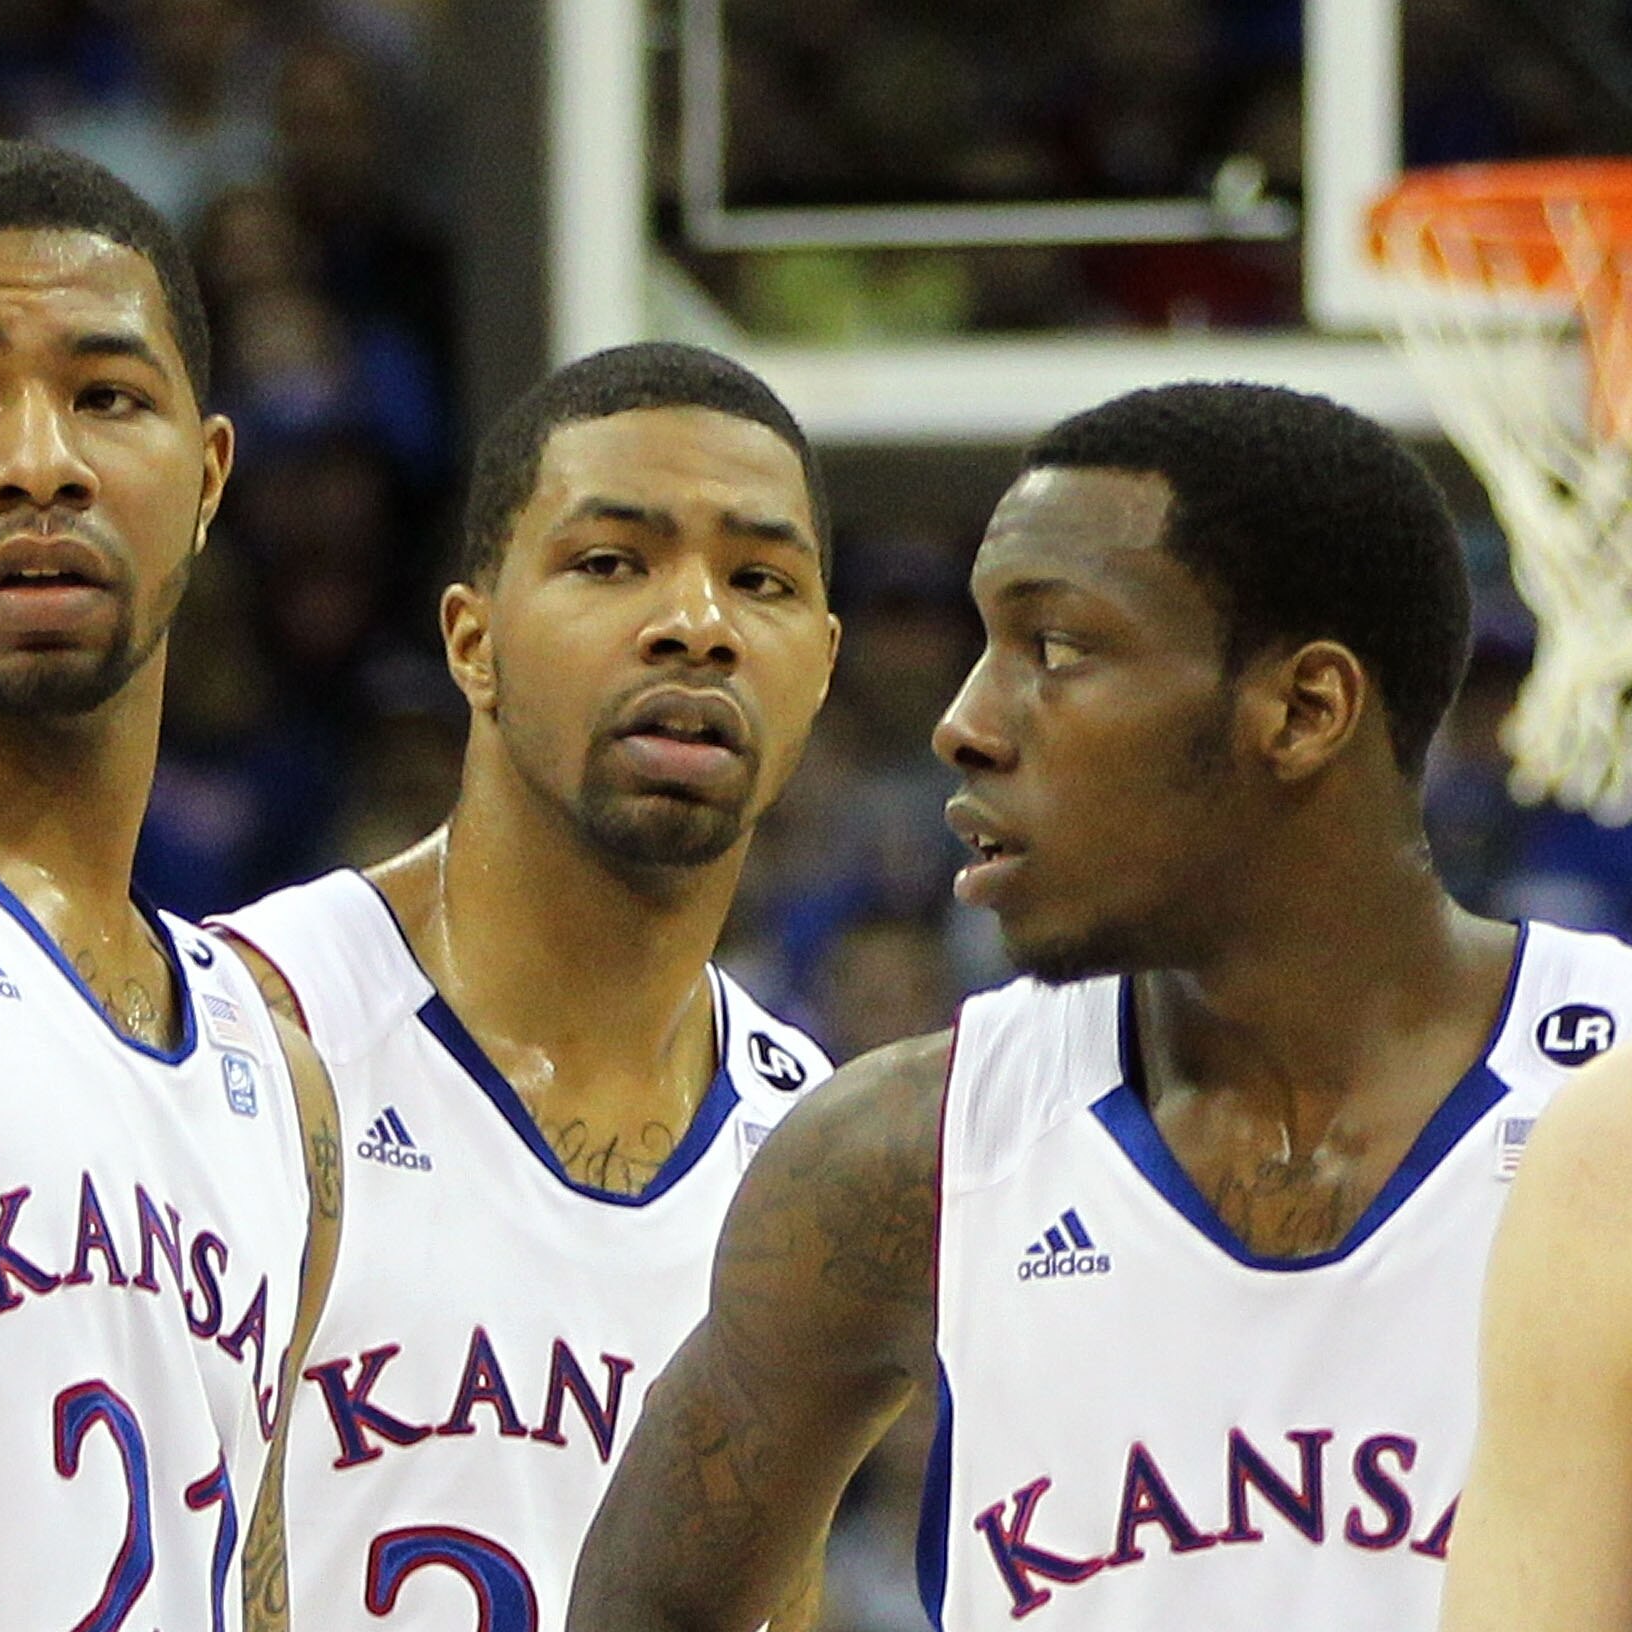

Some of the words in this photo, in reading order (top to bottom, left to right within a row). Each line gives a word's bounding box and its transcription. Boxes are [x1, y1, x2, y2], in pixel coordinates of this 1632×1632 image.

[1542, 1015, 1612, 1052] LR
[749, 1035, 803, 1082] LR
[357, 1141, 432, 1172] adidas
[1017, 1249, 1111, 1281] adidas
